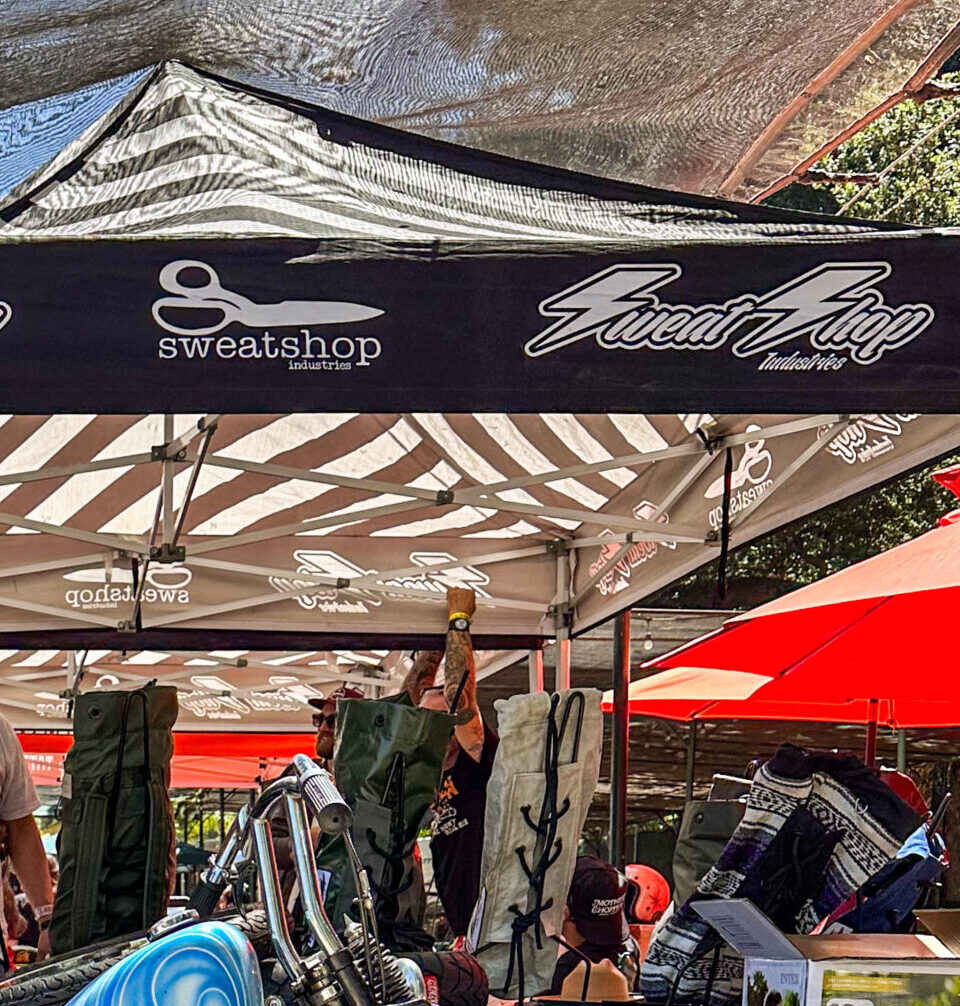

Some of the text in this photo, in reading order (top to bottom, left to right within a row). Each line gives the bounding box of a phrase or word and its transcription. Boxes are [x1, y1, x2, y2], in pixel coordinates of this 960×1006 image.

[524, 261, 935, 366] Sweat Shop
[157, 329, 382, 367] sweatshop
[287, 360, 352, 371] industries
[757, 351, 847, 372] Industries
[780, 973, 800, 985] INTEX
